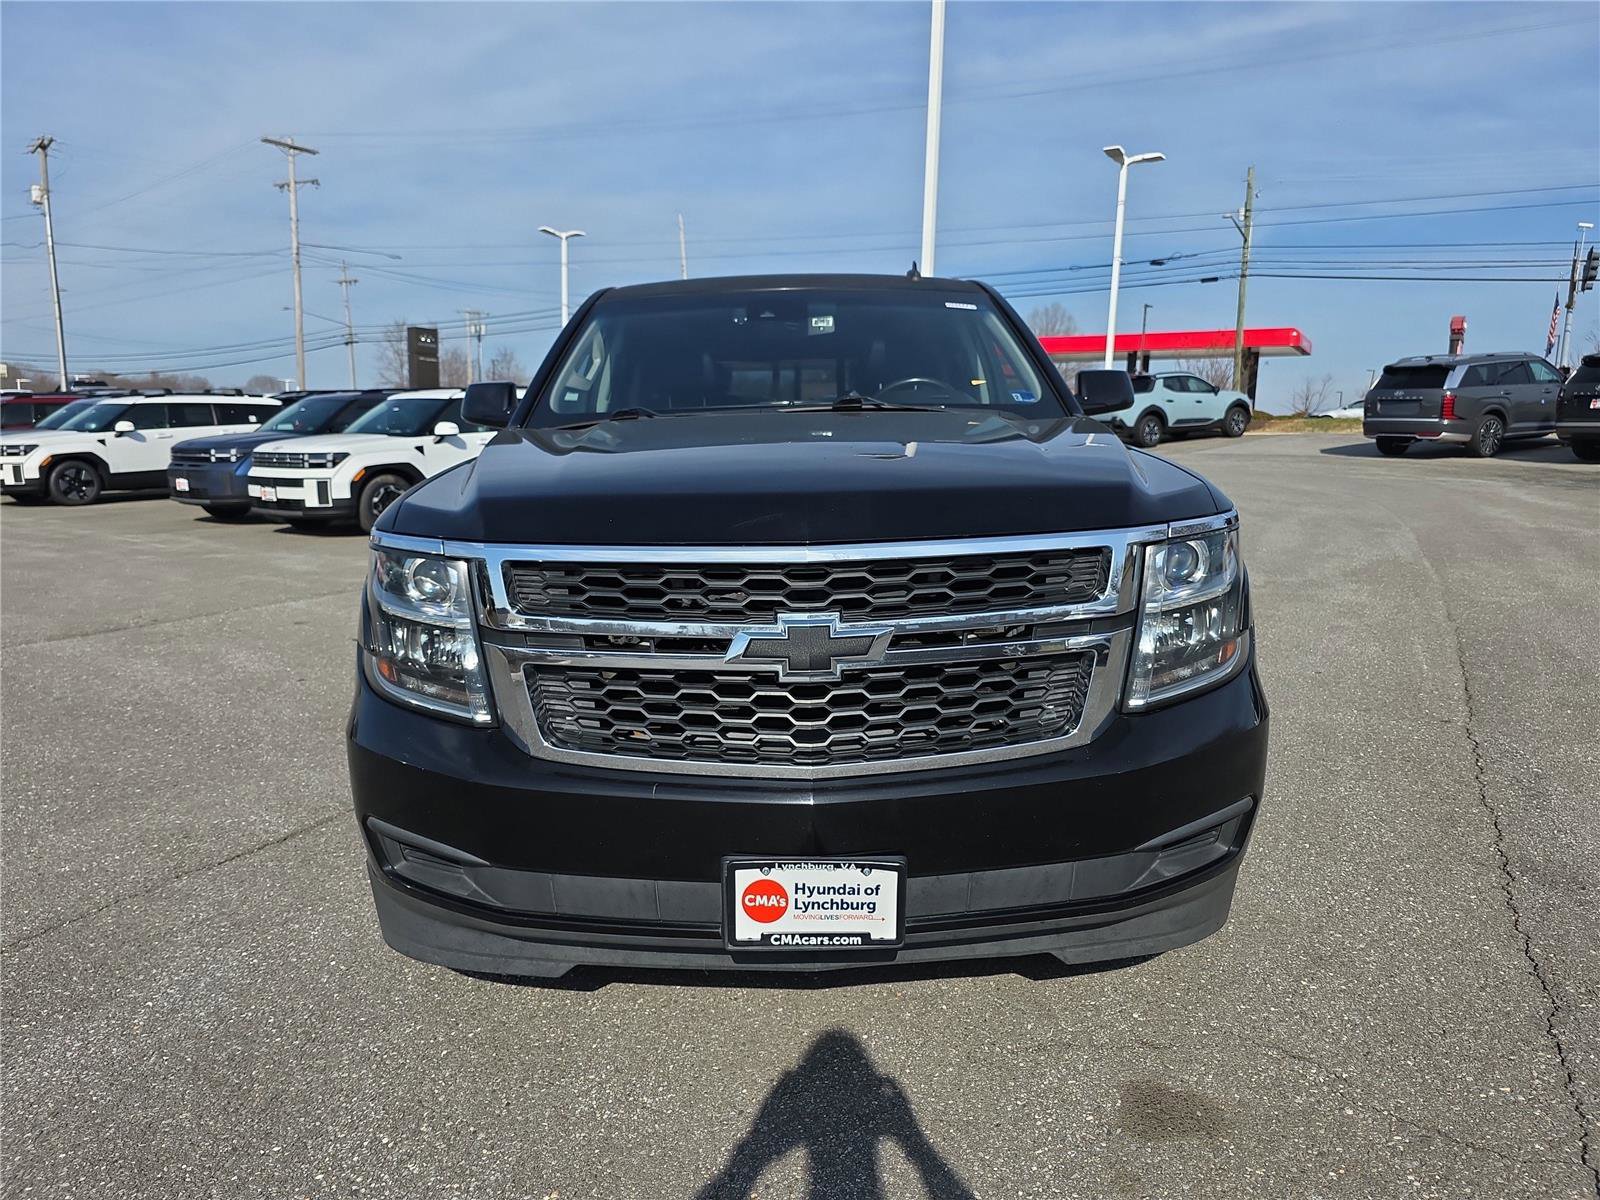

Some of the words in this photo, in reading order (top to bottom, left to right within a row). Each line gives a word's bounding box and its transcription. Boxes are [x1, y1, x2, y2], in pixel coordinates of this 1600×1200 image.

[794, 883, 860, 898] Hyundai
[864, 884, 881, 896] of
[744, 894, 787, 907] CMA's
[794, 898, 876, 913] Lynchburg
[770, 934, 862, 945] CMAcars.com
